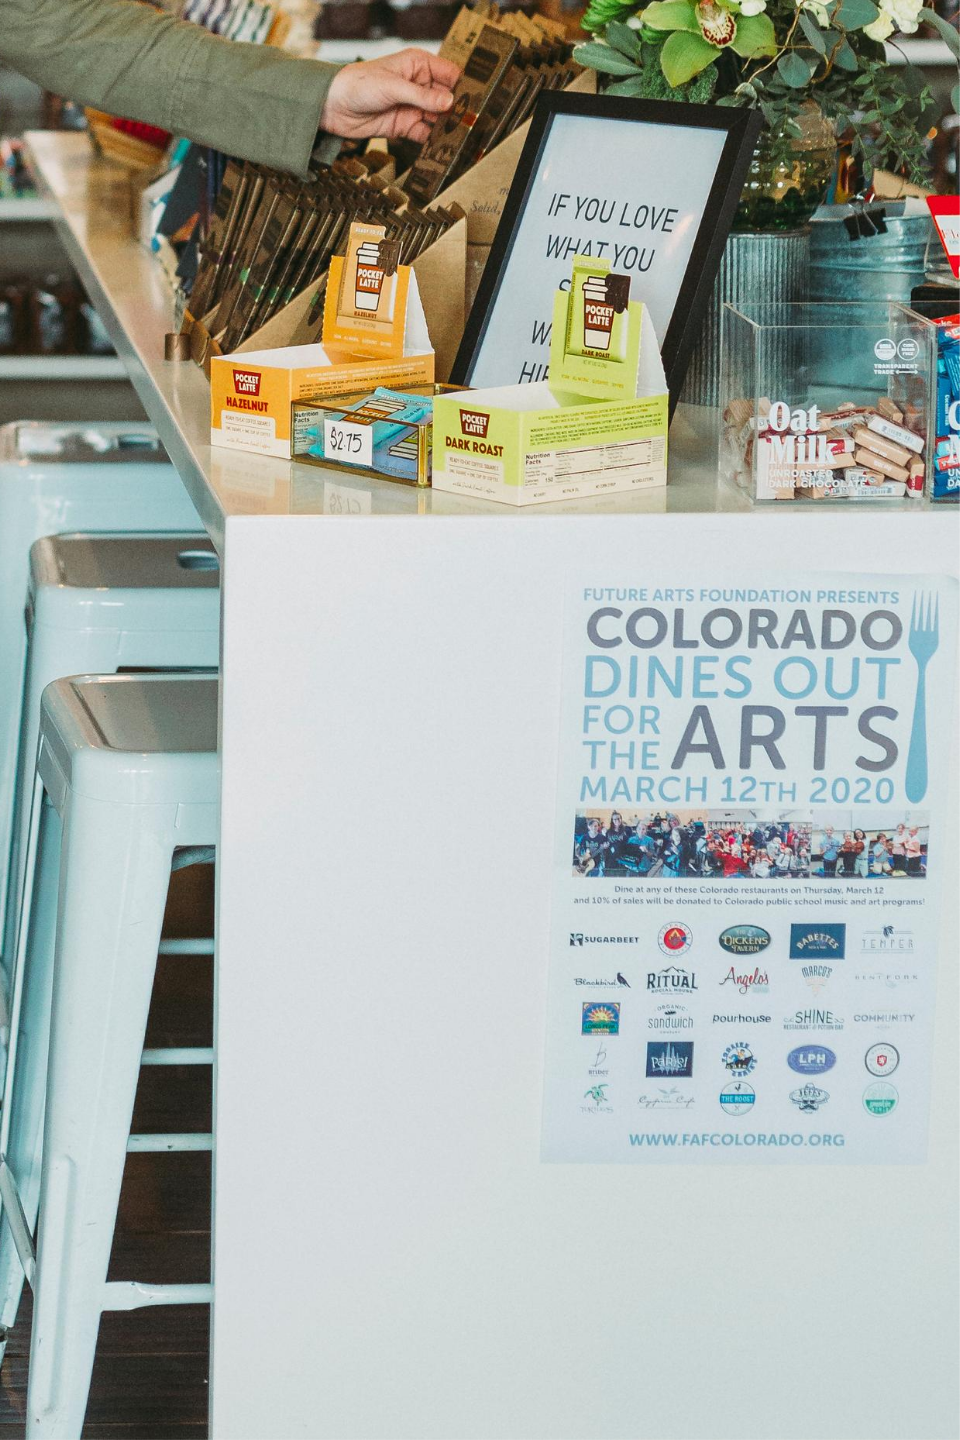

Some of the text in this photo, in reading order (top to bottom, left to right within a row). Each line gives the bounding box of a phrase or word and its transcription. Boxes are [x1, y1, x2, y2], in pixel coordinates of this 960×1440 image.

[547, 193, 678, 233] IF YOU LOVE
[546, 234, 656, 272] WHAT YOU
[357, 268, 384, 279] POCKET
[359, 278, 379, 289] LATTE
[353, 310, 377, 320] HAZELNUT
[585, 304, 614, 317] POCKET
[588, 315, 610, 327] LATTE
[581, 348, 611, 359] DARK ROAST
[235, 373, 259, 386] POCKET
[238, 382, 257, 393] LATTE
[226, 396, 269, 413] HAZELNUT
[461, 413, 488, 426] POCKET
[768, 401, 822, 432] Oat
[465, 423, 484, 435] LATTE
[329, 426, 363, 453] $2.75
[445, 435, 504, 457] DARK ROAST
[526, 452, 551, 460] Nutrition
[768, 434, 838, 465] Milk
[769, 469, 834, 478] UNROASTED
[769, 479, 866, 488] DARK CHOCOLATE
[583, 587, 900, 604] FUTURE ARTS FOUNDATION PRESENTS
[586, 606, 903, 651] COLORADO
[583, 654, 901, 700] DINES OUT
[582, 704, 661, 735] FOR
[670, 704, 899, 773] ARTS
[582, 740, 660, 770] THE
[579, 775, 895, 804] MARCH 12TH 2020
[614, 886, 634, 894] Dine
[635, 886, 644, 894] at
[646, 887, 661, 896] any
[663, 886, 673, 894] of
[675, 886, 698, 894] these
[699, 886, 739, 894] Colorado
[741, 887, 789, 895] restaurants
[804, 887, 844, 896] Thursday,
[846, 887, 873, 895] March
[874, 887, 885, 895] 12
[573, 897, 590, 905] and
[592, 897, 610, 905] 10%
[612, 897, 621, 905] of
[623, 897, 644, 905] sales
[646, 897, 662, 905] will
[663, 897, 674, 905] be
[676, 897, 711, 906] donated
[724, 897, 764, 906] Colorado
[766, 898, 792, 907] public
[794, 898, 822, 906] school
[824, 898, 848, 906] music
[850, 898, 867, 906] and
[868, 898, 880, 906] art
[882, 898, 925, 908] programs!
[584, 936, 639, 944] SUGARBEET
[796, 933, 839, 950] BABETTES
[862, 939, 914, 949] TEMPER
[646, 972, 699, 990] RITUAL
[795, 1009, 834, 1024] SHINE
[799, 1053, 826, 1064] LPH
[629, 1133, 846, 1148] WWW.FAFCOLORADO.ORG
